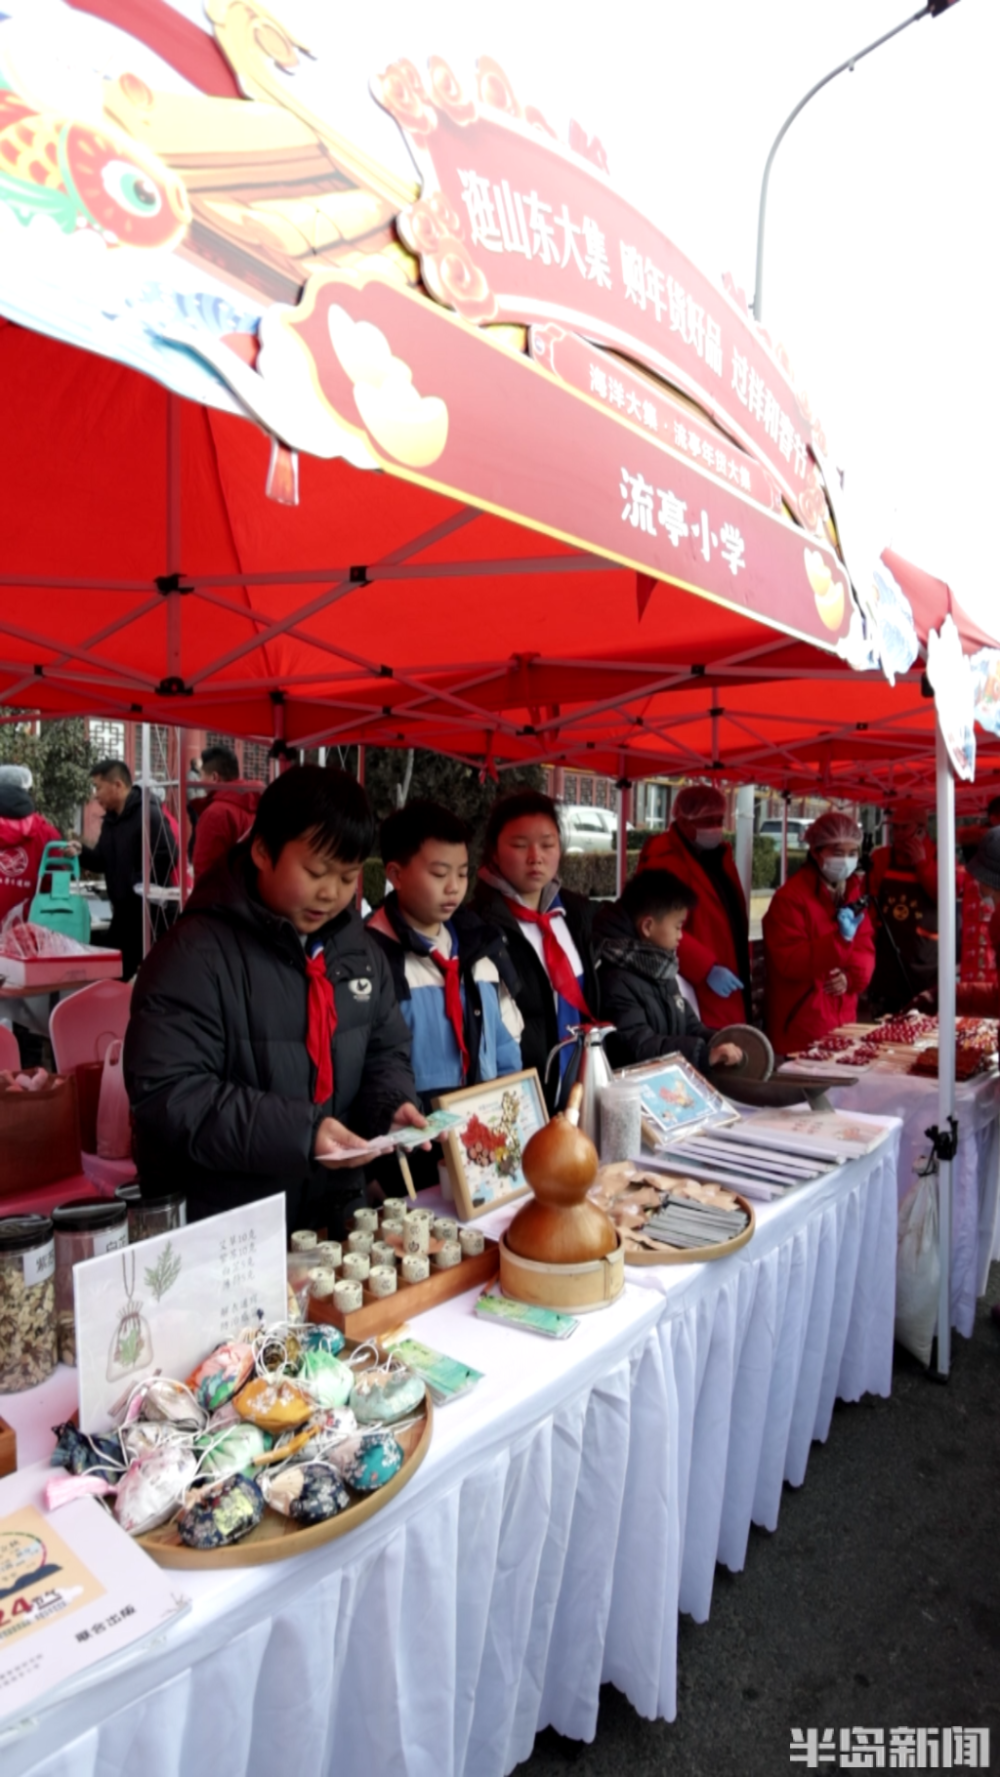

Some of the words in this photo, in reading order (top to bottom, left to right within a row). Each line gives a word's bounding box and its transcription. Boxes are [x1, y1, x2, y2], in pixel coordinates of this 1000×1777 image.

[456, 168, 612, 290] 逛山东大集
[619, 239, 723, 377] 购年货好品
[619, 467, 746, 576] 流亭小学
